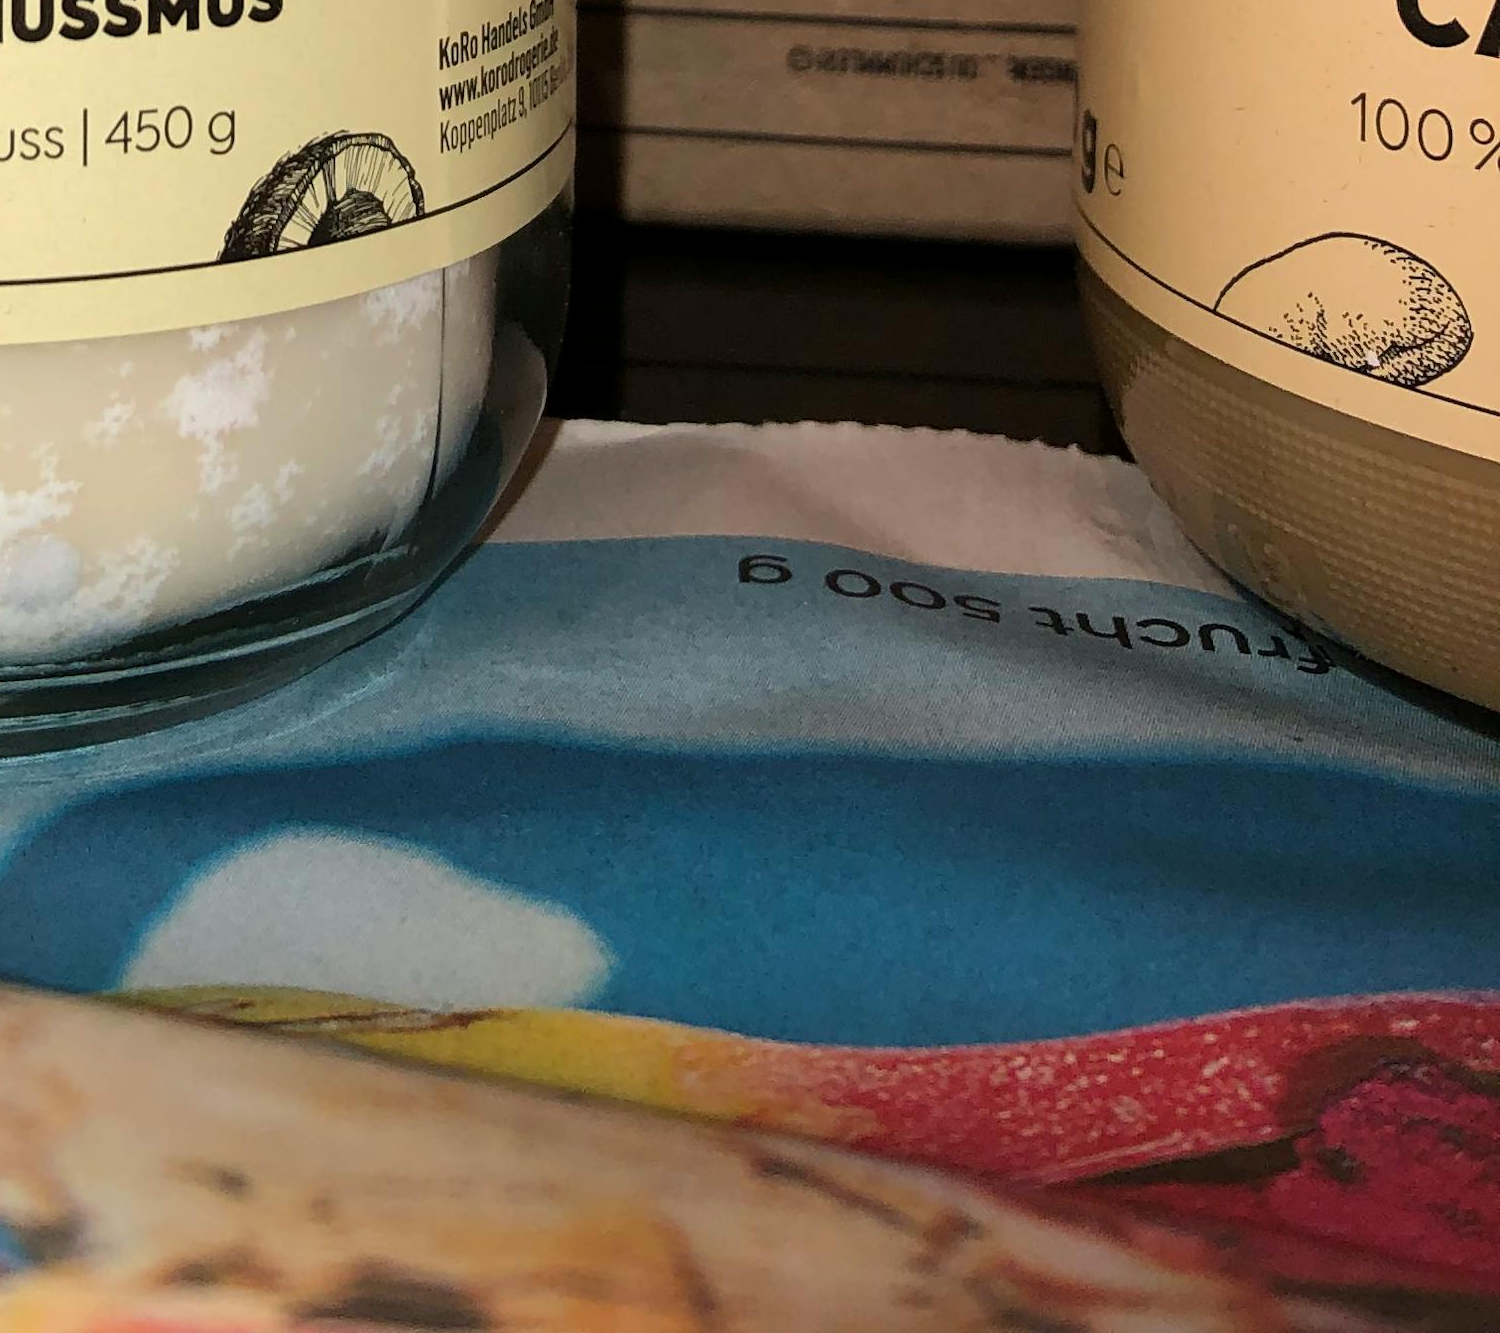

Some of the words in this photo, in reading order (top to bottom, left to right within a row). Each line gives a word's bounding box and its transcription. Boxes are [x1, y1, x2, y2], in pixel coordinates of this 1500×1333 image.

[438, 31, 478, 71] KoRo
[481, 6, 527, 56] Handels
[438, 25, 559, 112] www.korodrogerie.de
[104, 105, 194, 154] 450
[208, 108, 237, 154] g
[439, 96, 517, 154] Koppenplatz
[518, 86, 527, 118] 9,
[1351, 92, 1453, 161] 100
[738, 554, 793, 584] g
[825, 568, 1000, 623] 500
